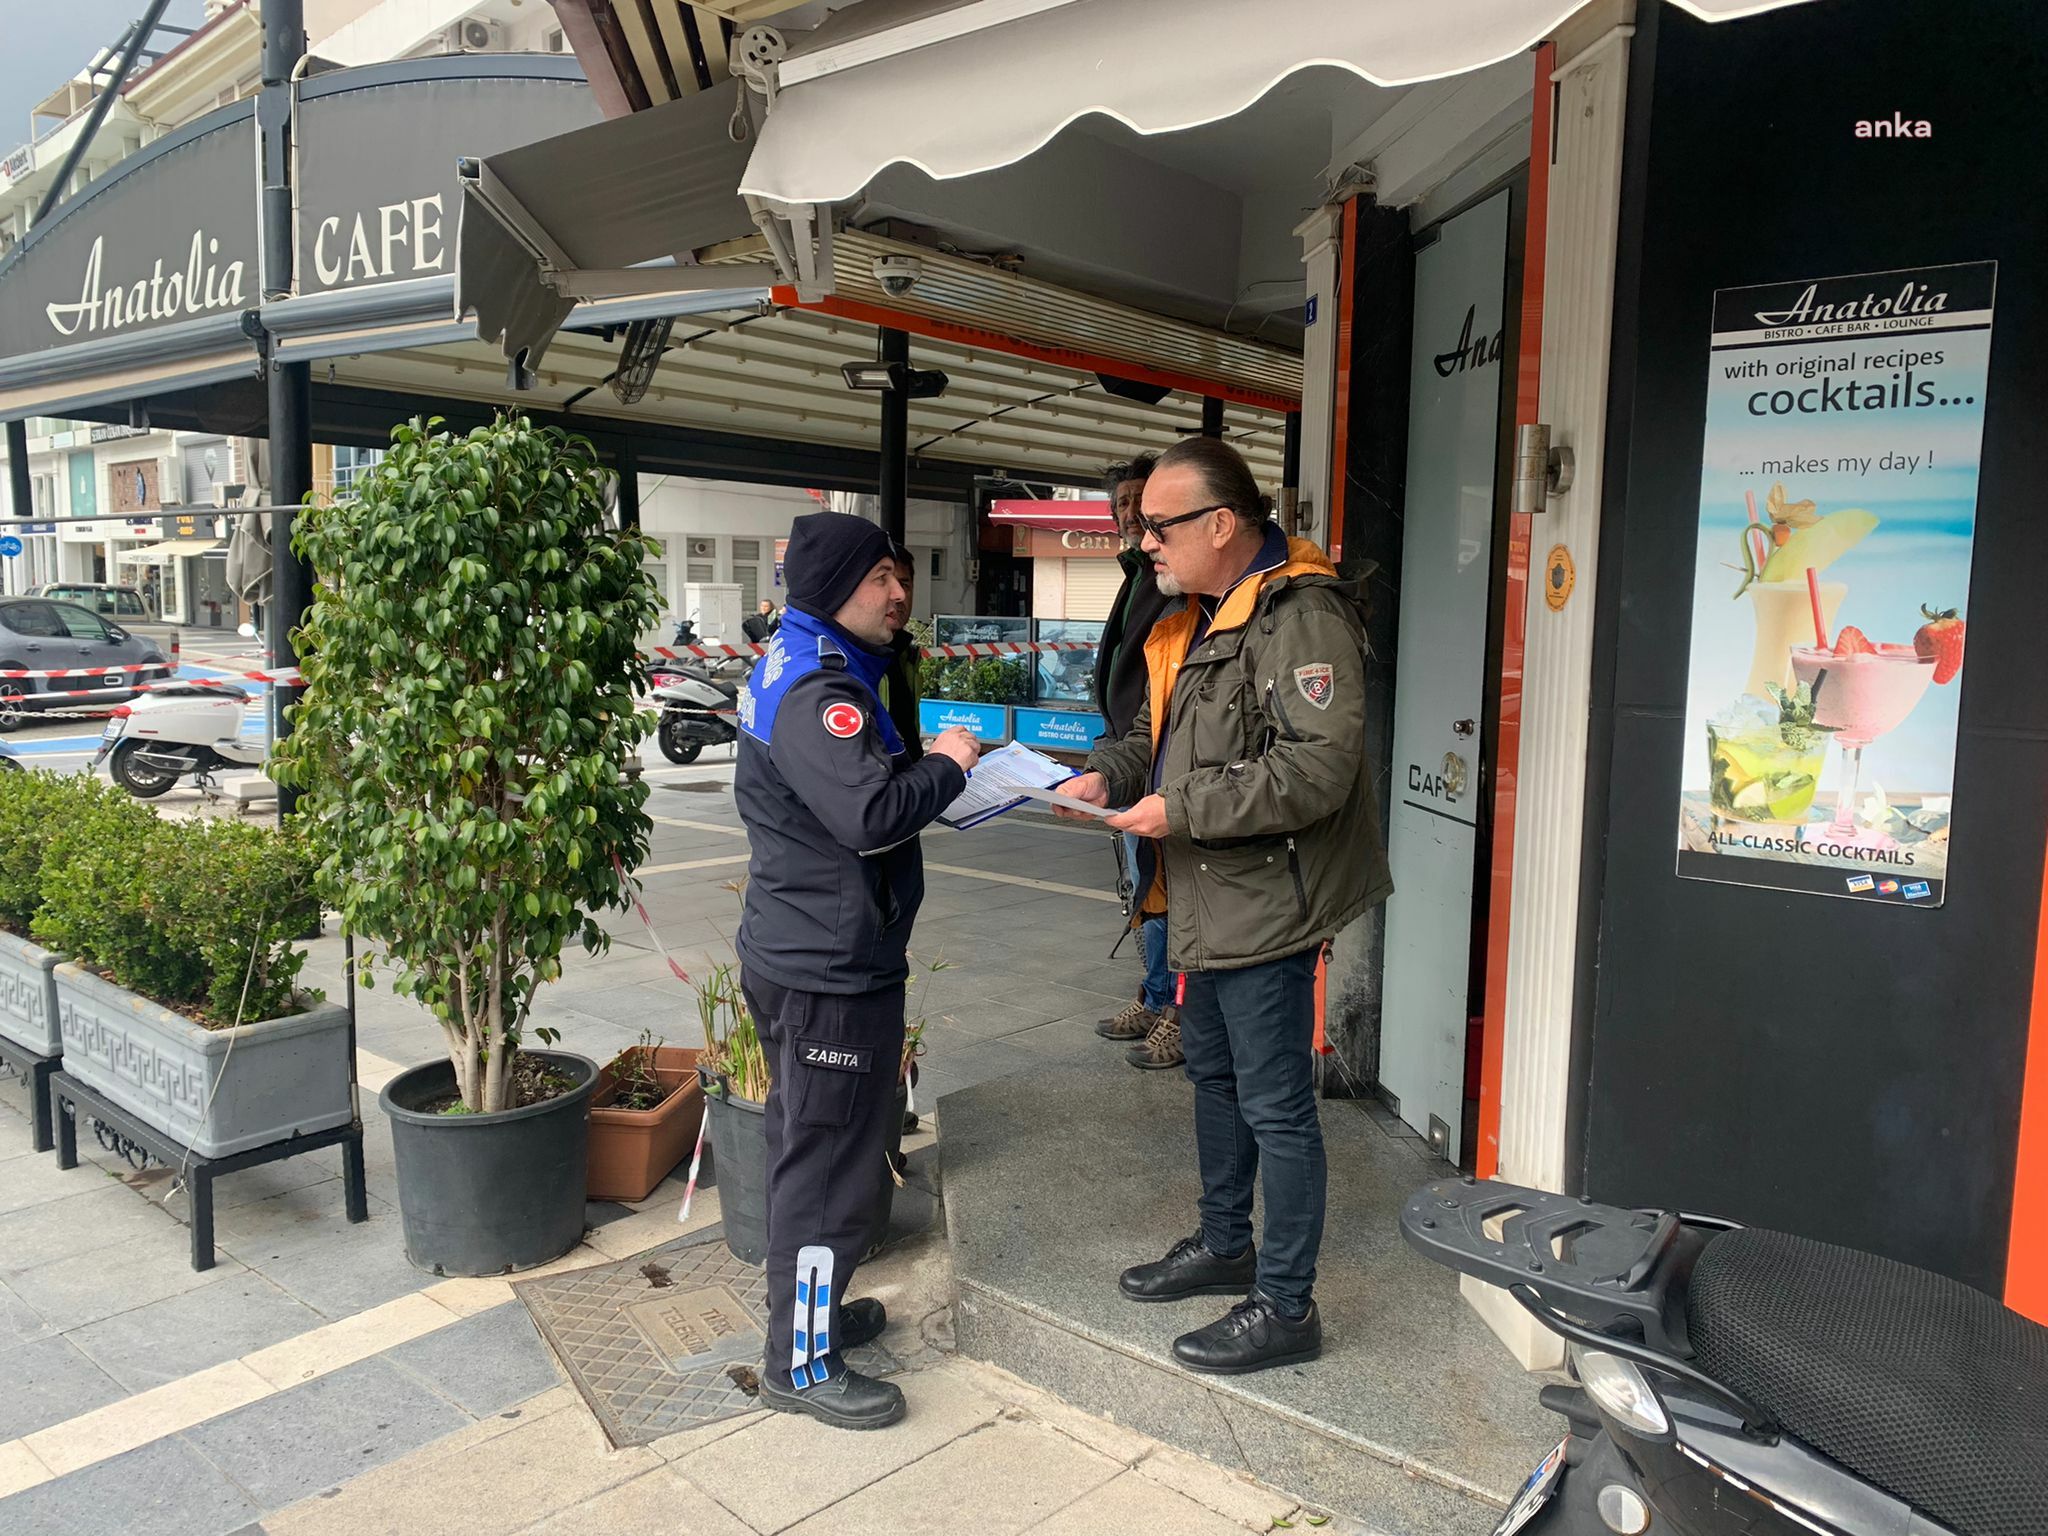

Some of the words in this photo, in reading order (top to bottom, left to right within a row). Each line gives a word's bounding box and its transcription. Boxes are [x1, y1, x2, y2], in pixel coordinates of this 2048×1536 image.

[313, 192, 444, 286] CAFE
[46, 229, 246, 335] Anatolia
[1754, 281, 1949, 326] Anatolia
[1764, 328, 1804, 340] BISTRO
[1815, 325, 1843, 336] CAFE
[1847, 322, 1871, 333] BAR
[1883, 317, 1935, 330] LOUNGE
[1724, 360, 1769, 379] with
[1775, 352, 1856, 379] original
[1864, 349, 1945, 371] recipes
[1748, 371, 1975, 416] cocktails...
[1761, 455, 1829, 474] makes
[1837, 457, 1872, 476] my
[1879, 451, 1920, 474] day
[940, 709, 981, 724] Anatolia
[1040, 716, 1085, 733] Anatolia
[1038, 731, 1059, 739] BISTRO
[1076, 734, 1088, 742] BAR
[1708, 831, 1736, 847] ALL
[1742, 834, 1812, 855] CLASSIC
[1816, 842, 1915, 866] COCKTAILS
[806, 1048, 858, 1067] ZABITA
